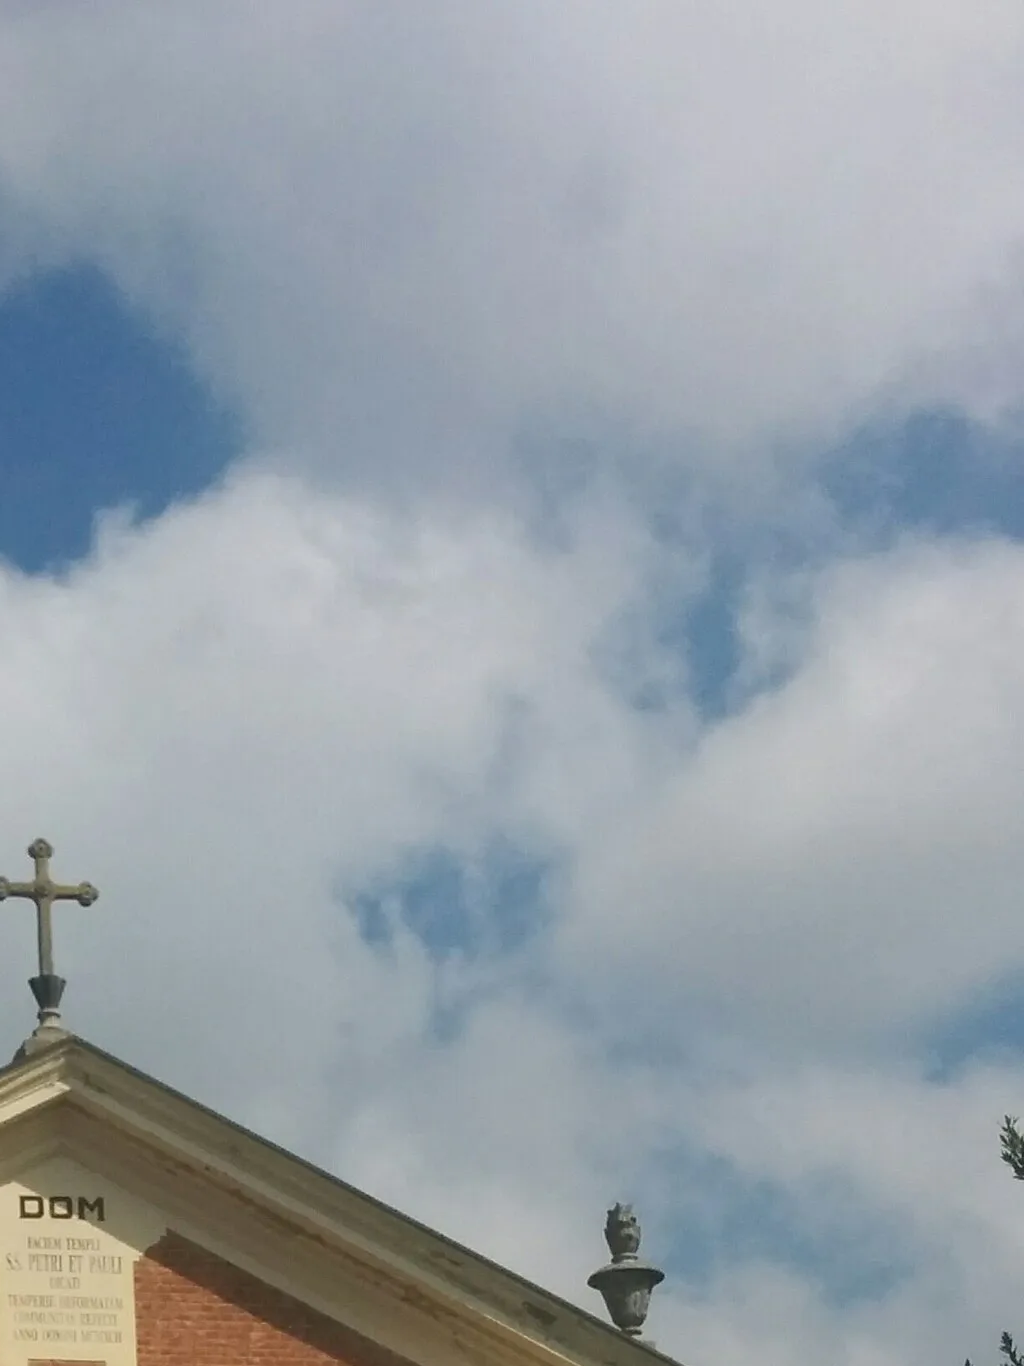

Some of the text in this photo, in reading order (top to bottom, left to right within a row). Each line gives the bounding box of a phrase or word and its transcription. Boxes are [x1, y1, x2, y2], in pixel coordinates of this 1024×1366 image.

[19, 1196, 105, 1222] DOM
[28, 1254, 63, 1273] PETRI
[68, 1255, 84, 1274] ET
[89, 1256, 123, 1275] PAULI
